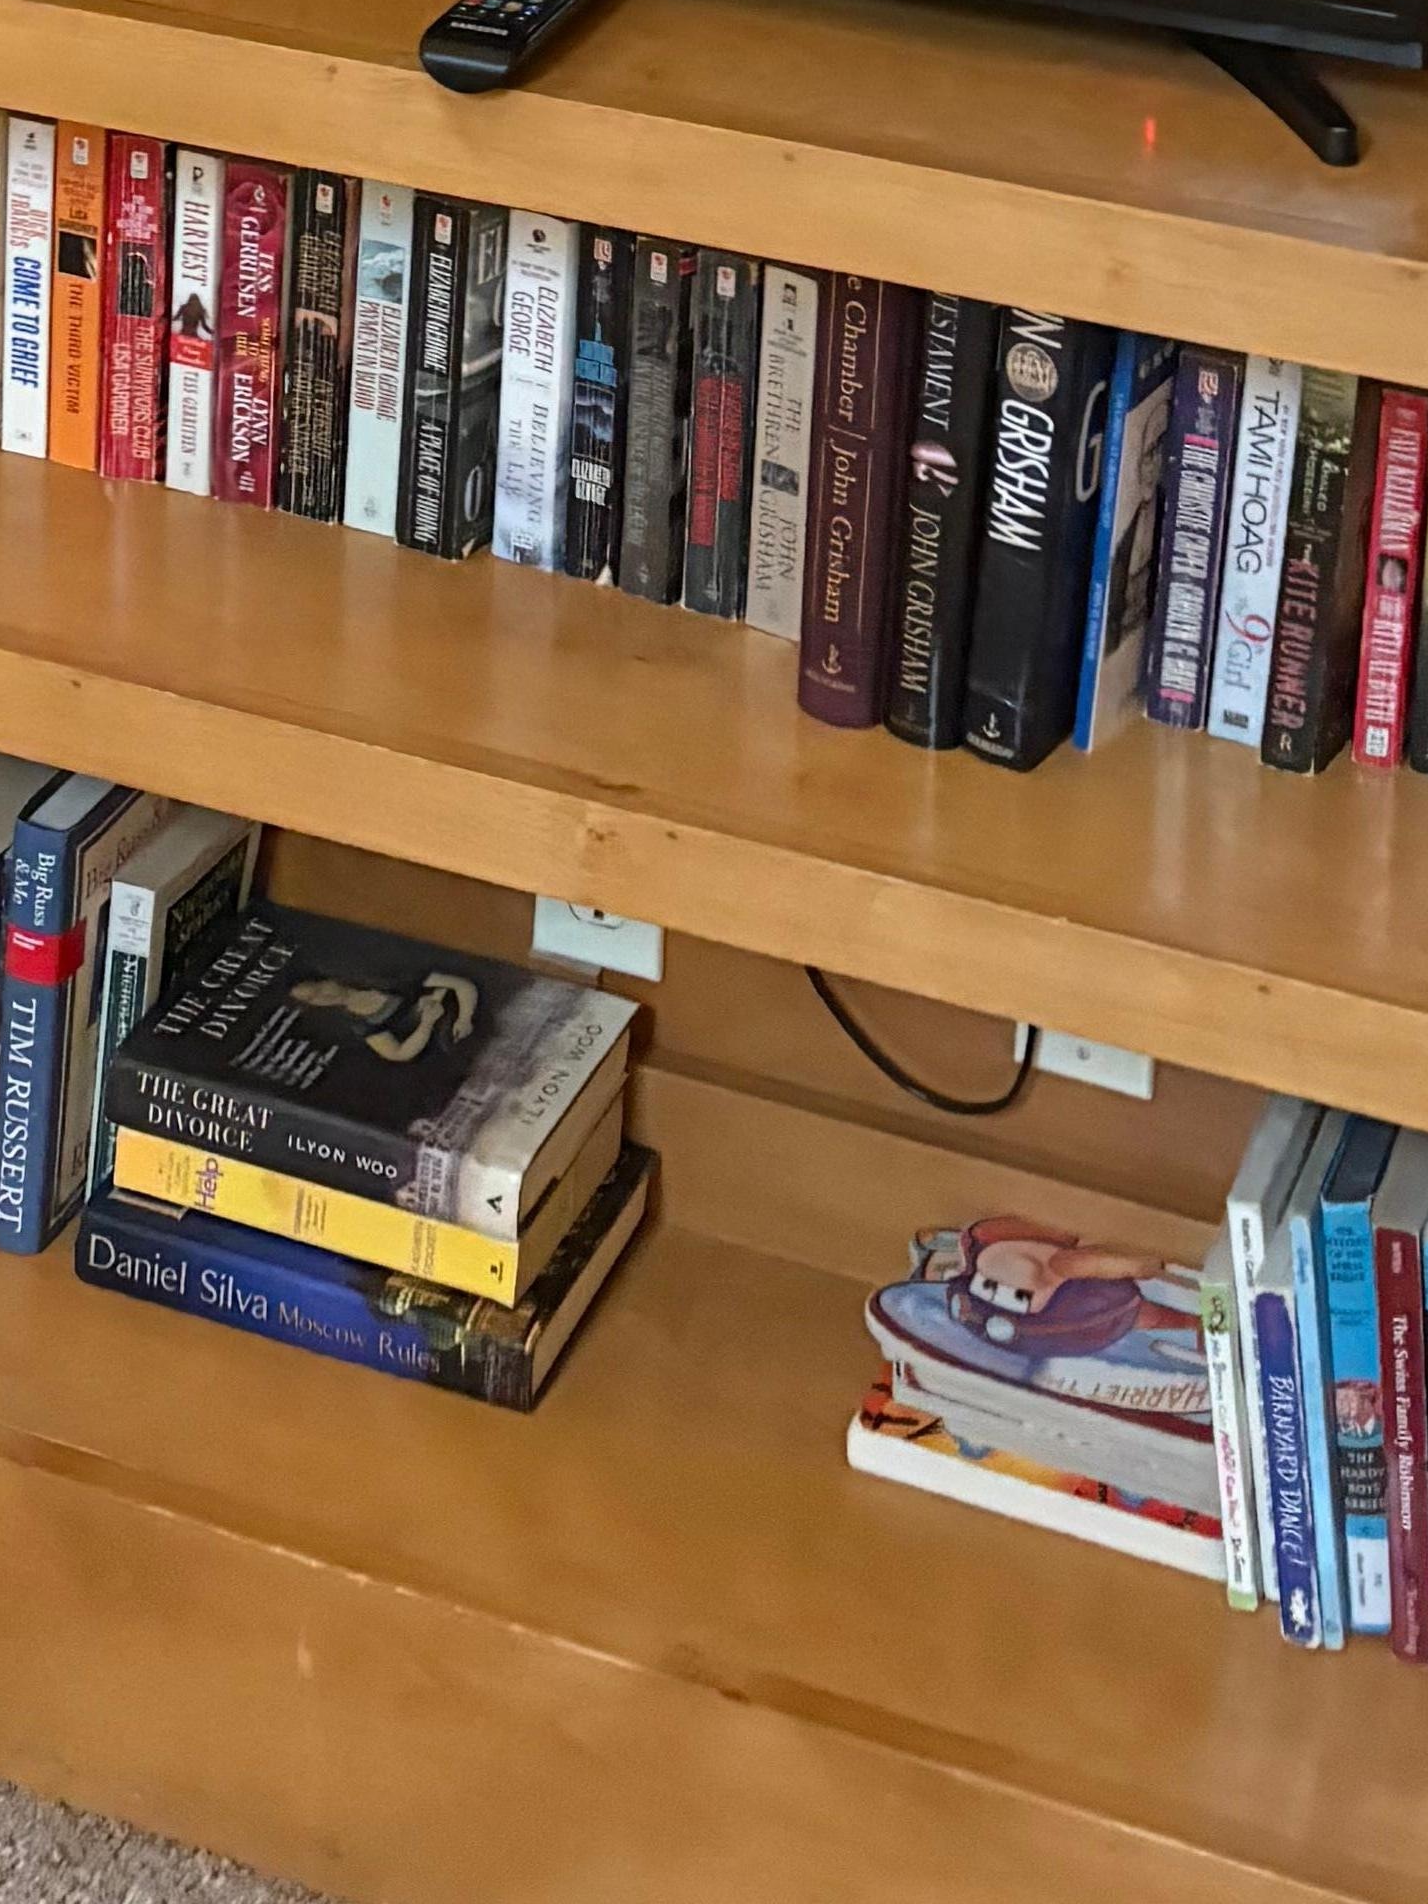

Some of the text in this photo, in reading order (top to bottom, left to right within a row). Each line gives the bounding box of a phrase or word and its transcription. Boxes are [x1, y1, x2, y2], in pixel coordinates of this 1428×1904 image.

[178, 198, 211, 289] HARVEST
[236, 216, 259, 318] GERRITSEN
[510, 290, 533, 358] GEORGE
[535, 284, 559, 373] ELIZABETH
[230, 373, 253, 463] ERICKSON
[824, 299, 867, 623] Chamber John Grisham
[987, 398, 1056, 552] GRISHAM
[1236, 390, 1280, 576] TAMI HOAG
[5, 997, 37, 1065] TIM
[137, 1071, 274, 1131] THE GREAT
[147, 1103, 254, 1154] DIVORCE
[286, 1133, 400, 1179] ILYON WOO
[86, 1232, 188, 1297] Daniel
[199, 1270, 269, 1322] Silva
[377, 1330, 441, 1375] Rules
[1269, 1373, 1309, 1570] BARNYARD DANCE!
